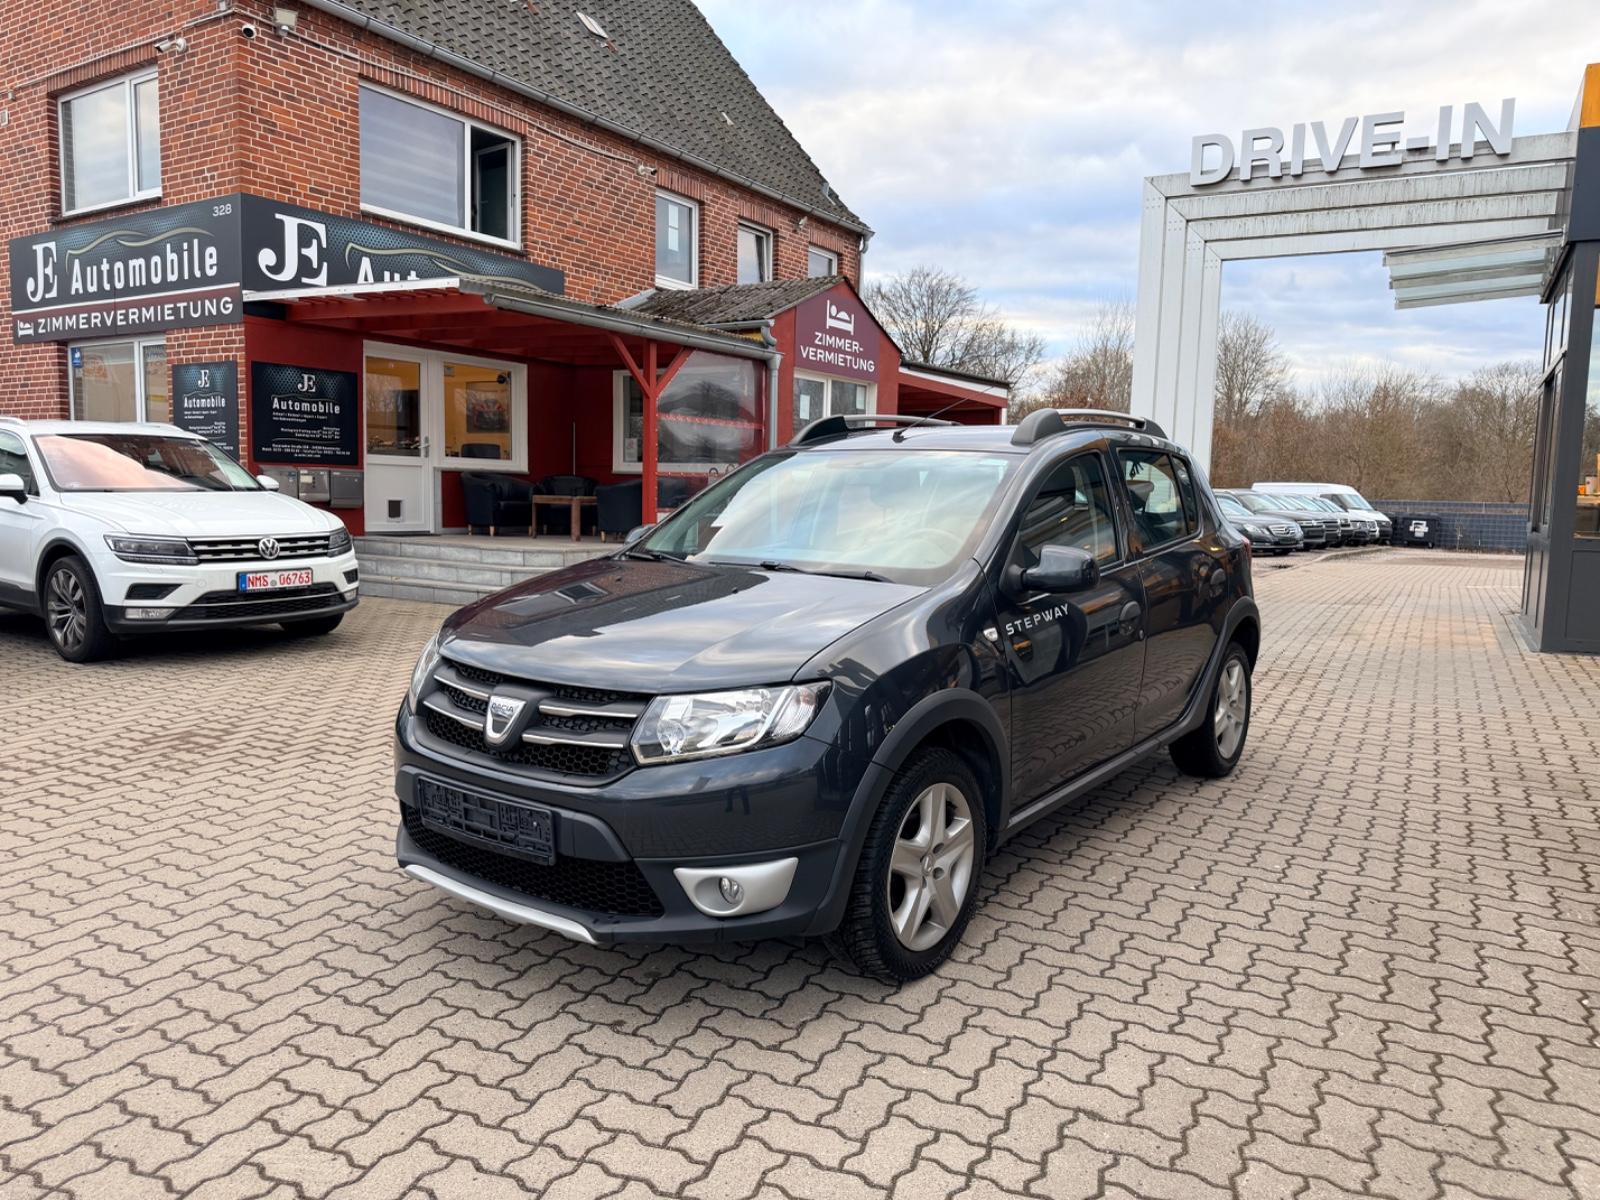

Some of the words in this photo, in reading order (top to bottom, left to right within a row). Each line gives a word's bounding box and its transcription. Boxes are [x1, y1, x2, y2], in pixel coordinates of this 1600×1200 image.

[1190, 98, 1515, 187] DRIVE-IN
[212, 204, 232, 216] 328
[258, 213, 328, 287] JE
[26, 241, 58, 302] JE
[70, 238, 218, 295] Automobile
[37, 297, 234, 334] ZIMMERVERMIETUNG
[814, 331, 864, 354] ZIMMER-
[800, 345, 875, 372] VERMIETUNG
[297, 373, 316, 392] JE
[183, 395, 226, 408] Automobile
[272, 397, 340, 414] Automobile
[247, 574, 269, 588] NMS
[279, 571, 310, 586] 06763
[1005, 603, 1069, 636] STEPWAY
